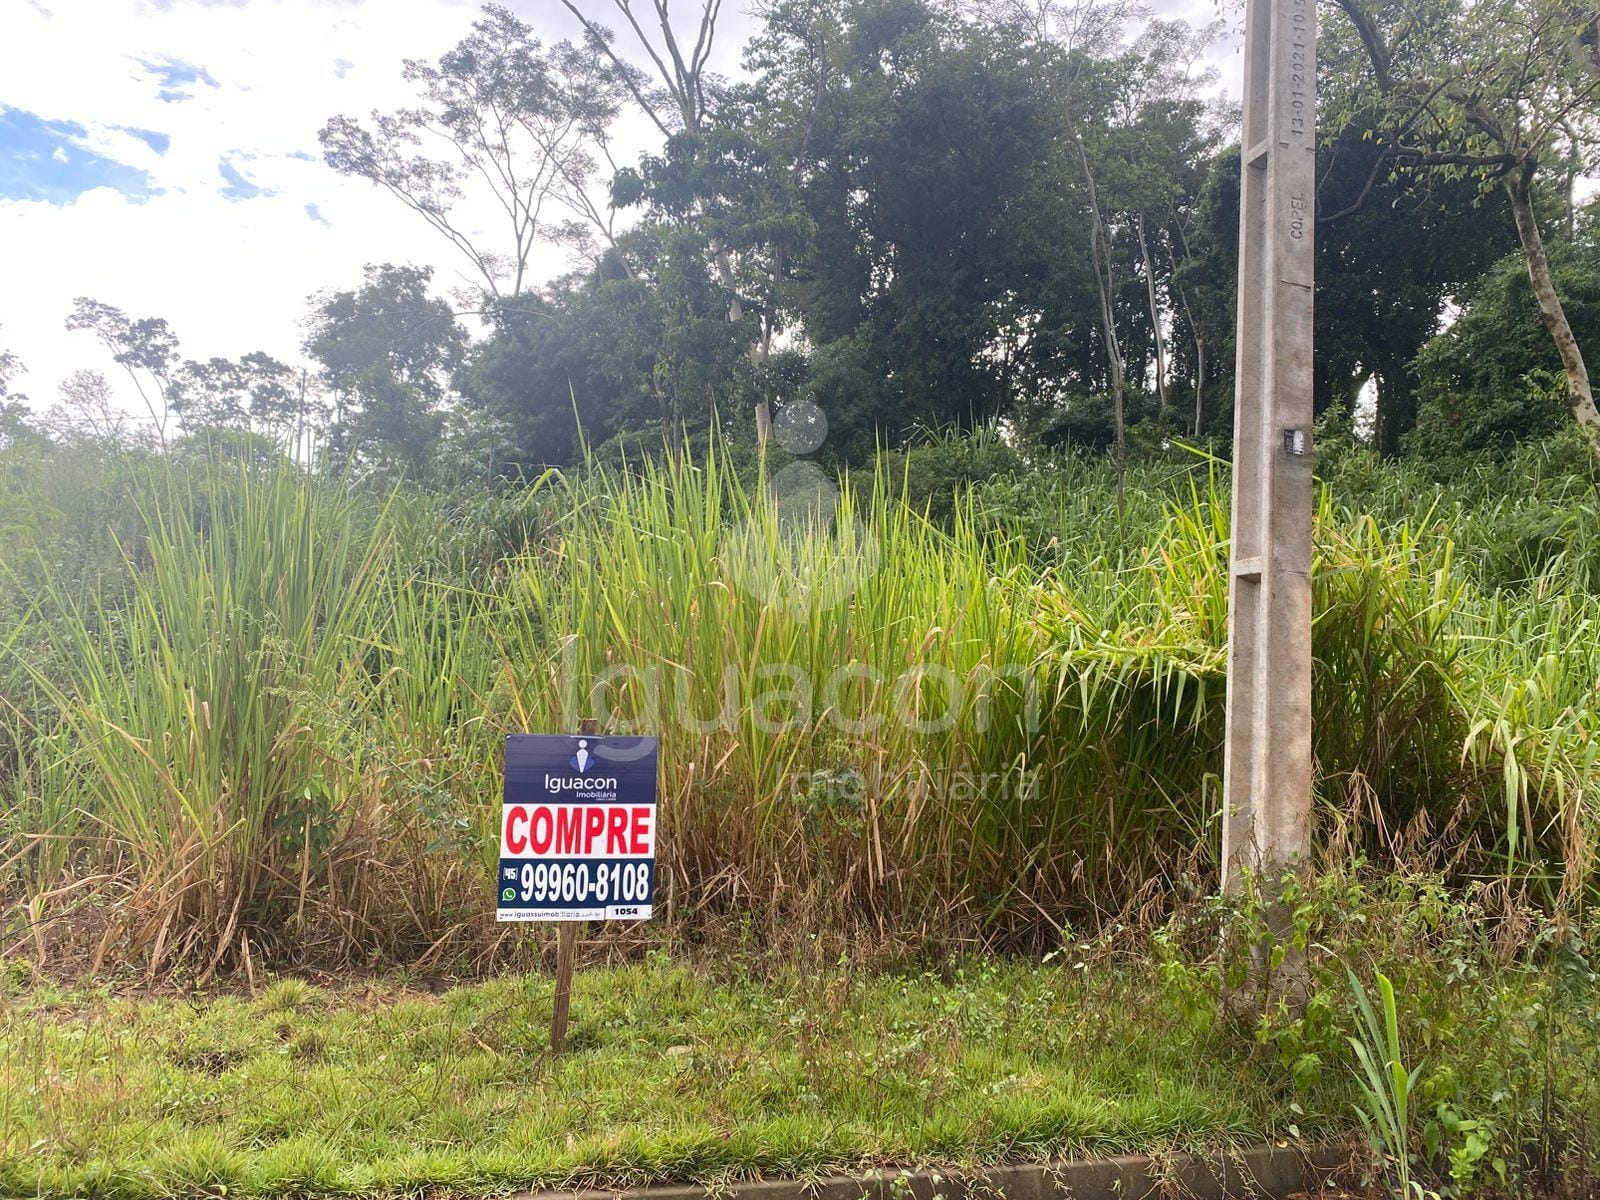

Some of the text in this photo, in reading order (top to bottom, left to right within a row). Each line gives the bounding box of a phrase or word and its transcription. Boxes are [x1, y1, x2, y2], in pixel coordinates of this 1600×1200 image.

[1290, 192, 1304, 240] COPEL
[545, 774, 617, 793] Iguacon
[505, 806, 651, 855] COMPRE
[520, 863, 649, 902] 99960-8108
[614, 907, 638, 916] 1054
